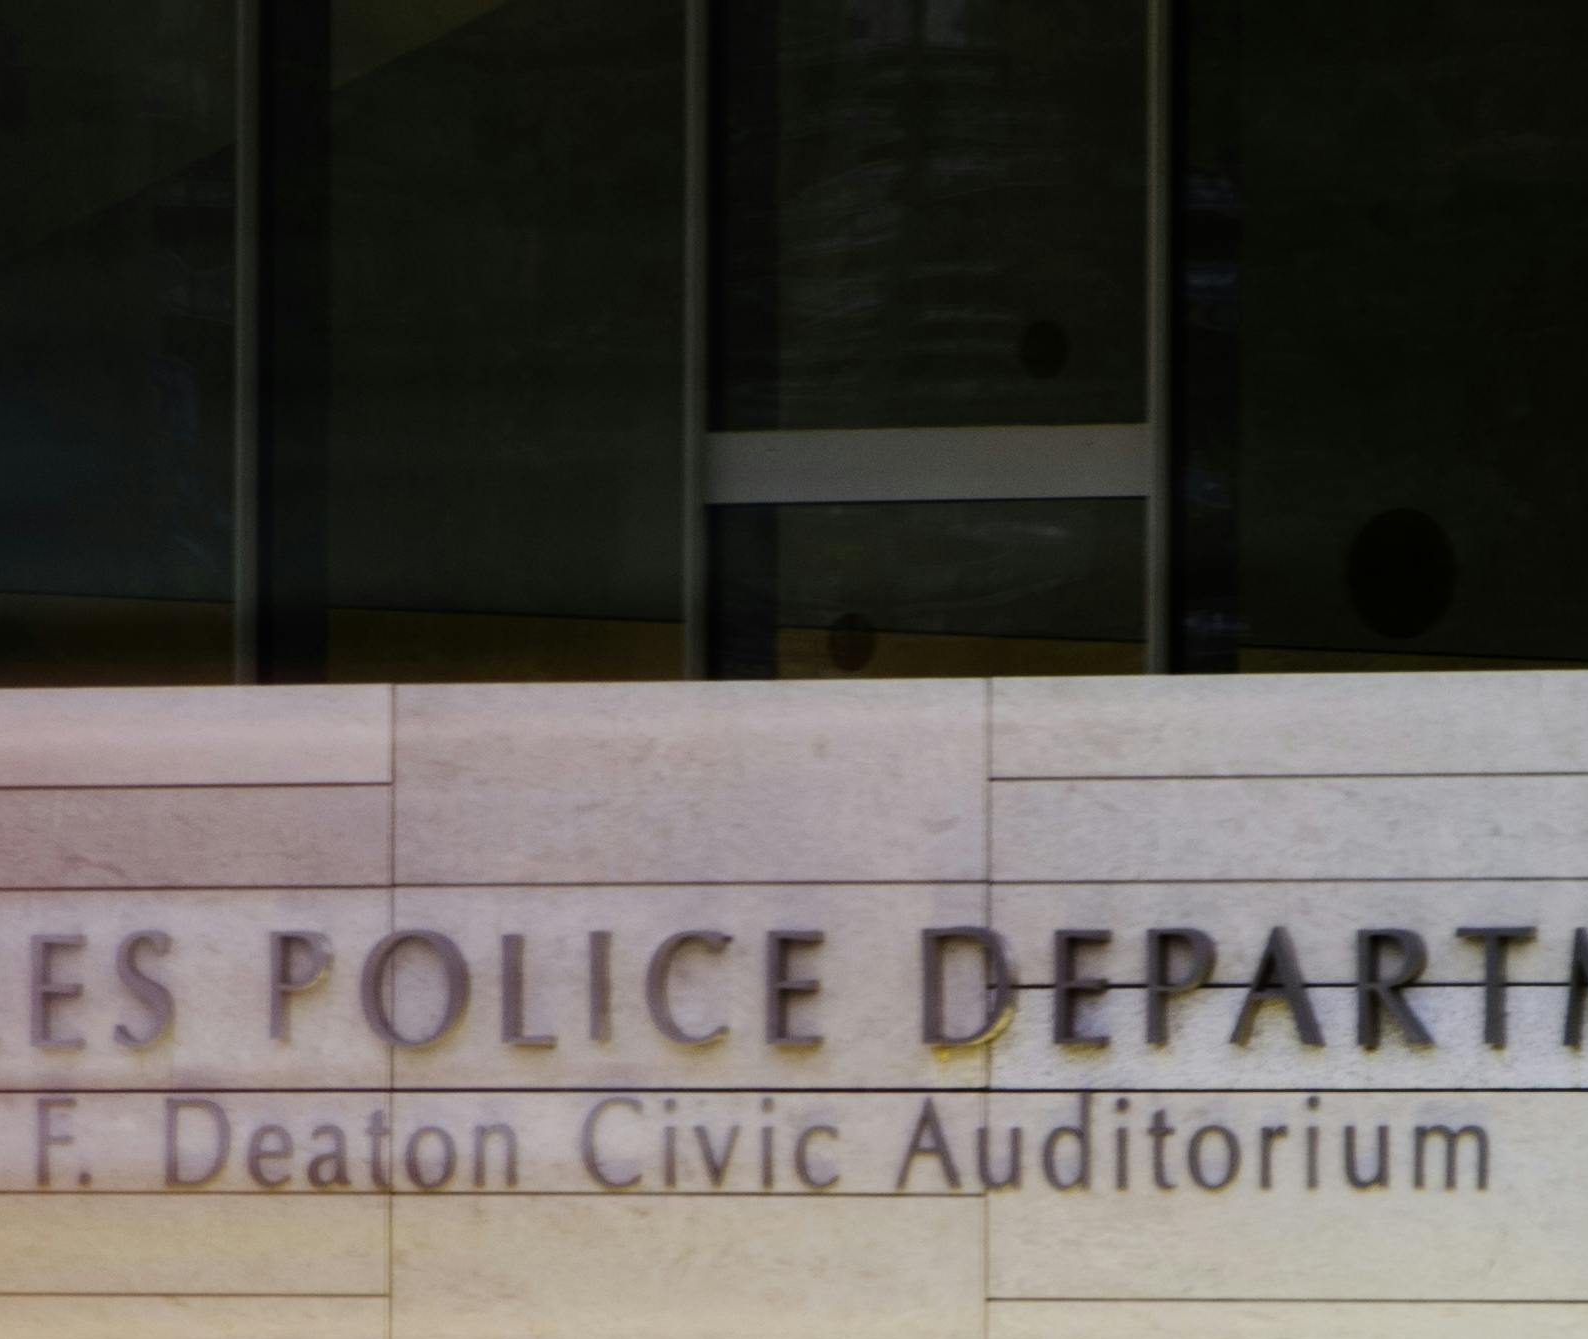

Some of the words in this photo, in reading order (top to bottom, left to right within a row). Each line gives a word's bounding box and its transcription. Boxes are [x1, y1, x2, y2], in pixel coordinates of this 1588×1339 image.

[269, 929, 824, 1048] POLICE
[36, 1097, 93, 1189] F.
[165, 1096, 519, 1191] Deaton
[580, 1095, 841, 1192] Civic
[895, 1092, 1490, 1192] Auditorium
